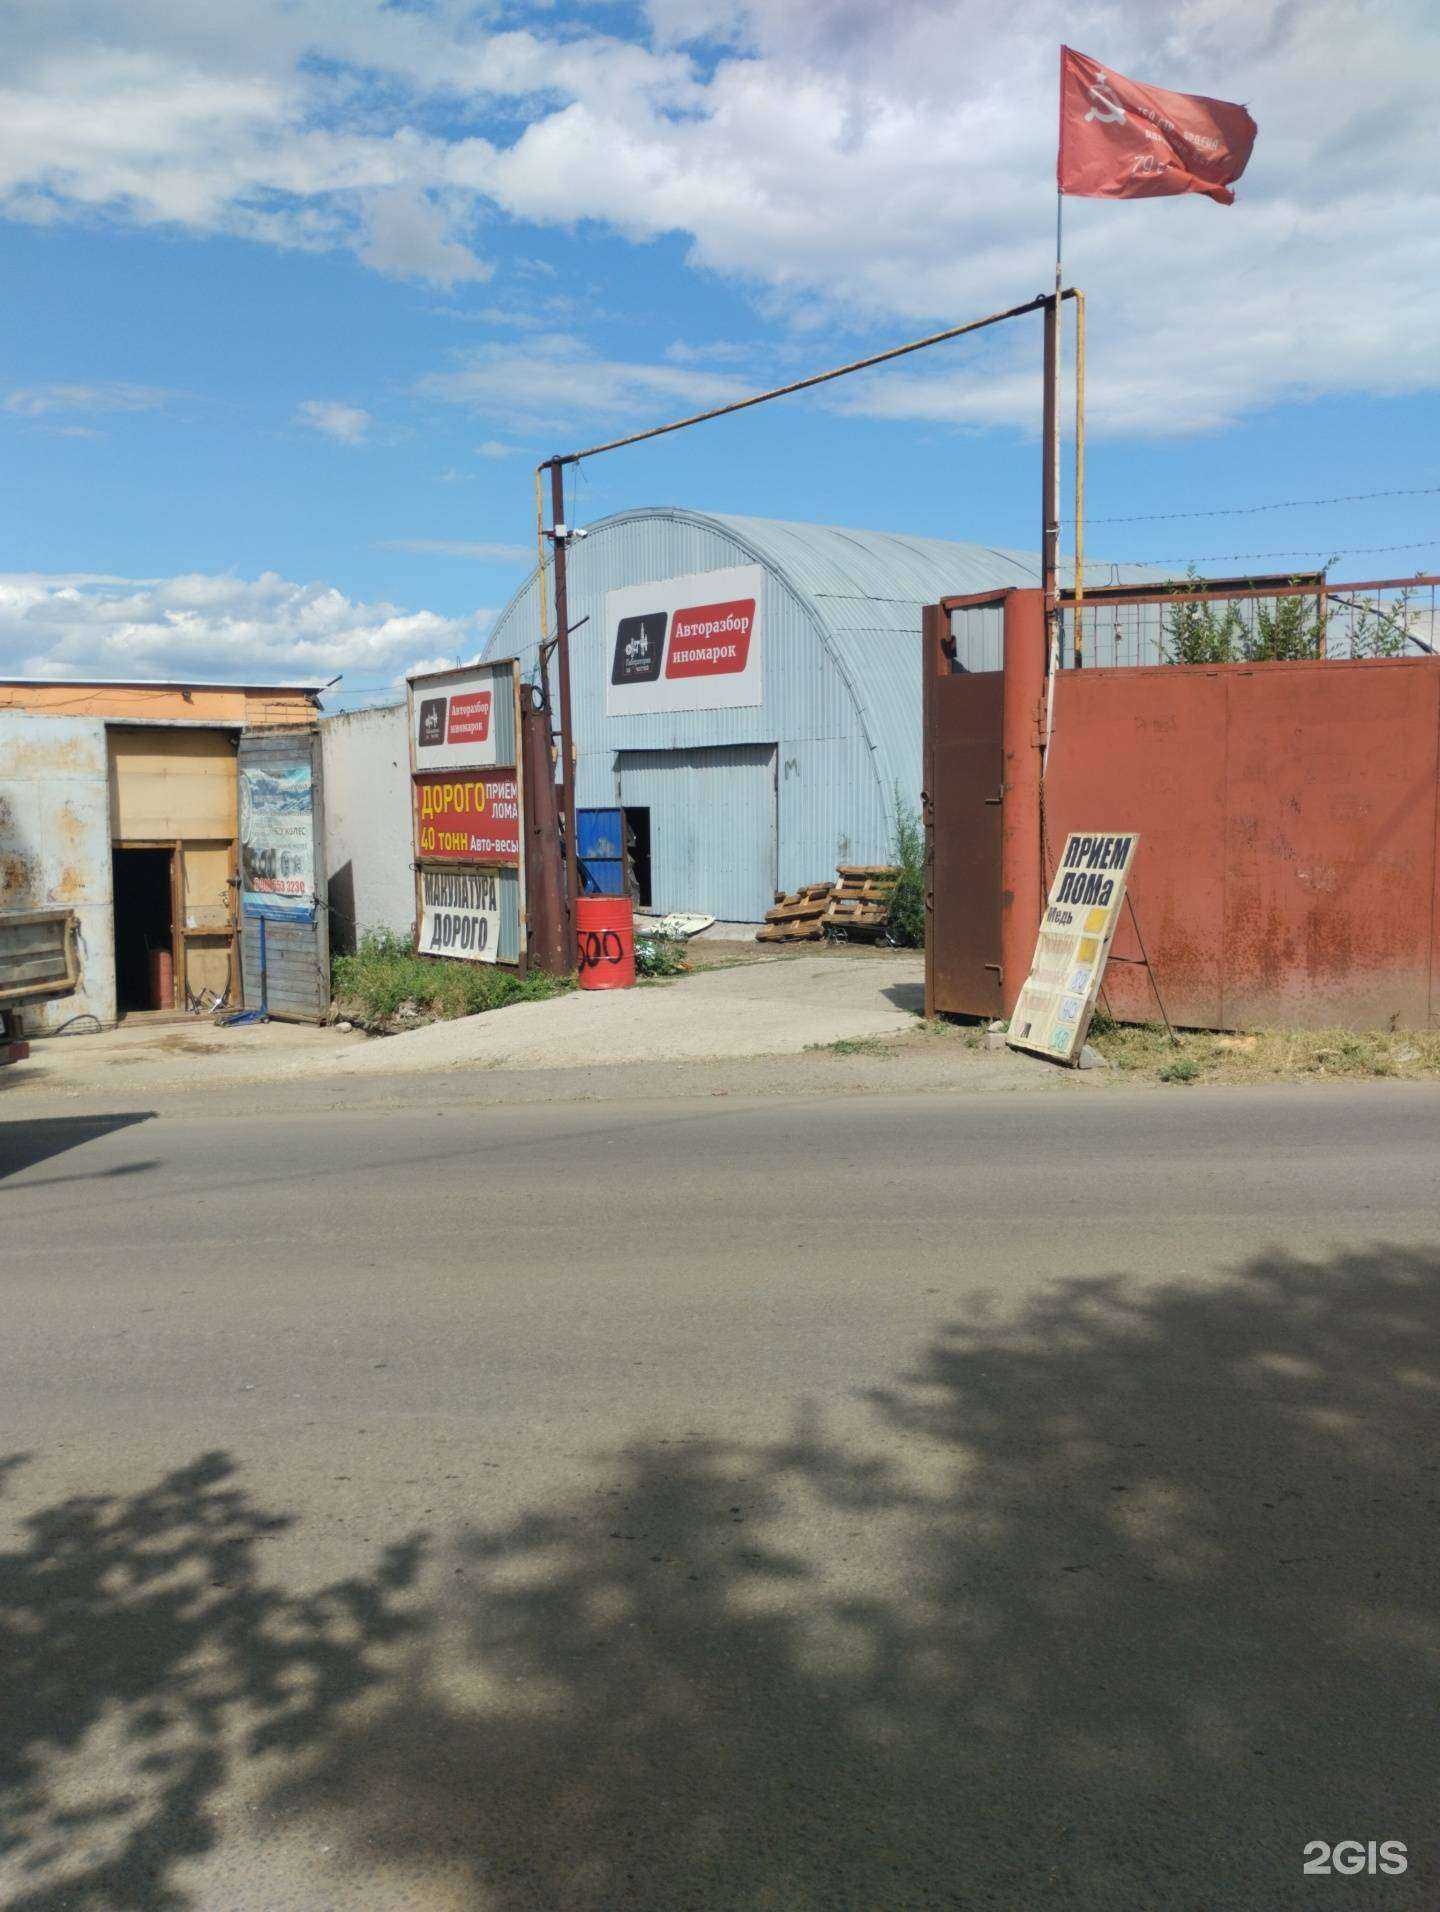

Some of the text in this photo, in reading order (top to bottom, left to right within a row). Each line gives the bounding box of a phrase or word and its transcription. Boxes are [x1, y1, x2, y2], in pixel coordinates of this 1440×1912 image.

[675, 613, 749, 638] Авторазбор
[672, 645, 737, 664] иномарок
[451, 701, 489, 717] Авторазбор
[450, 721, 483, 735] иномарок
[421, 782, 485, 820] ДОРОГО
[492, 802, 518, 819] ЛОМА
[421, 826, 435, 851] 40
[1063, 836, 1132, 869] ПРИЕМ
[424, 873, 497, 911] МАКУЛАТУРА
[1047, 906, 1073, 926] Медь
[430, 912, 488, 952] ДОРОГО
